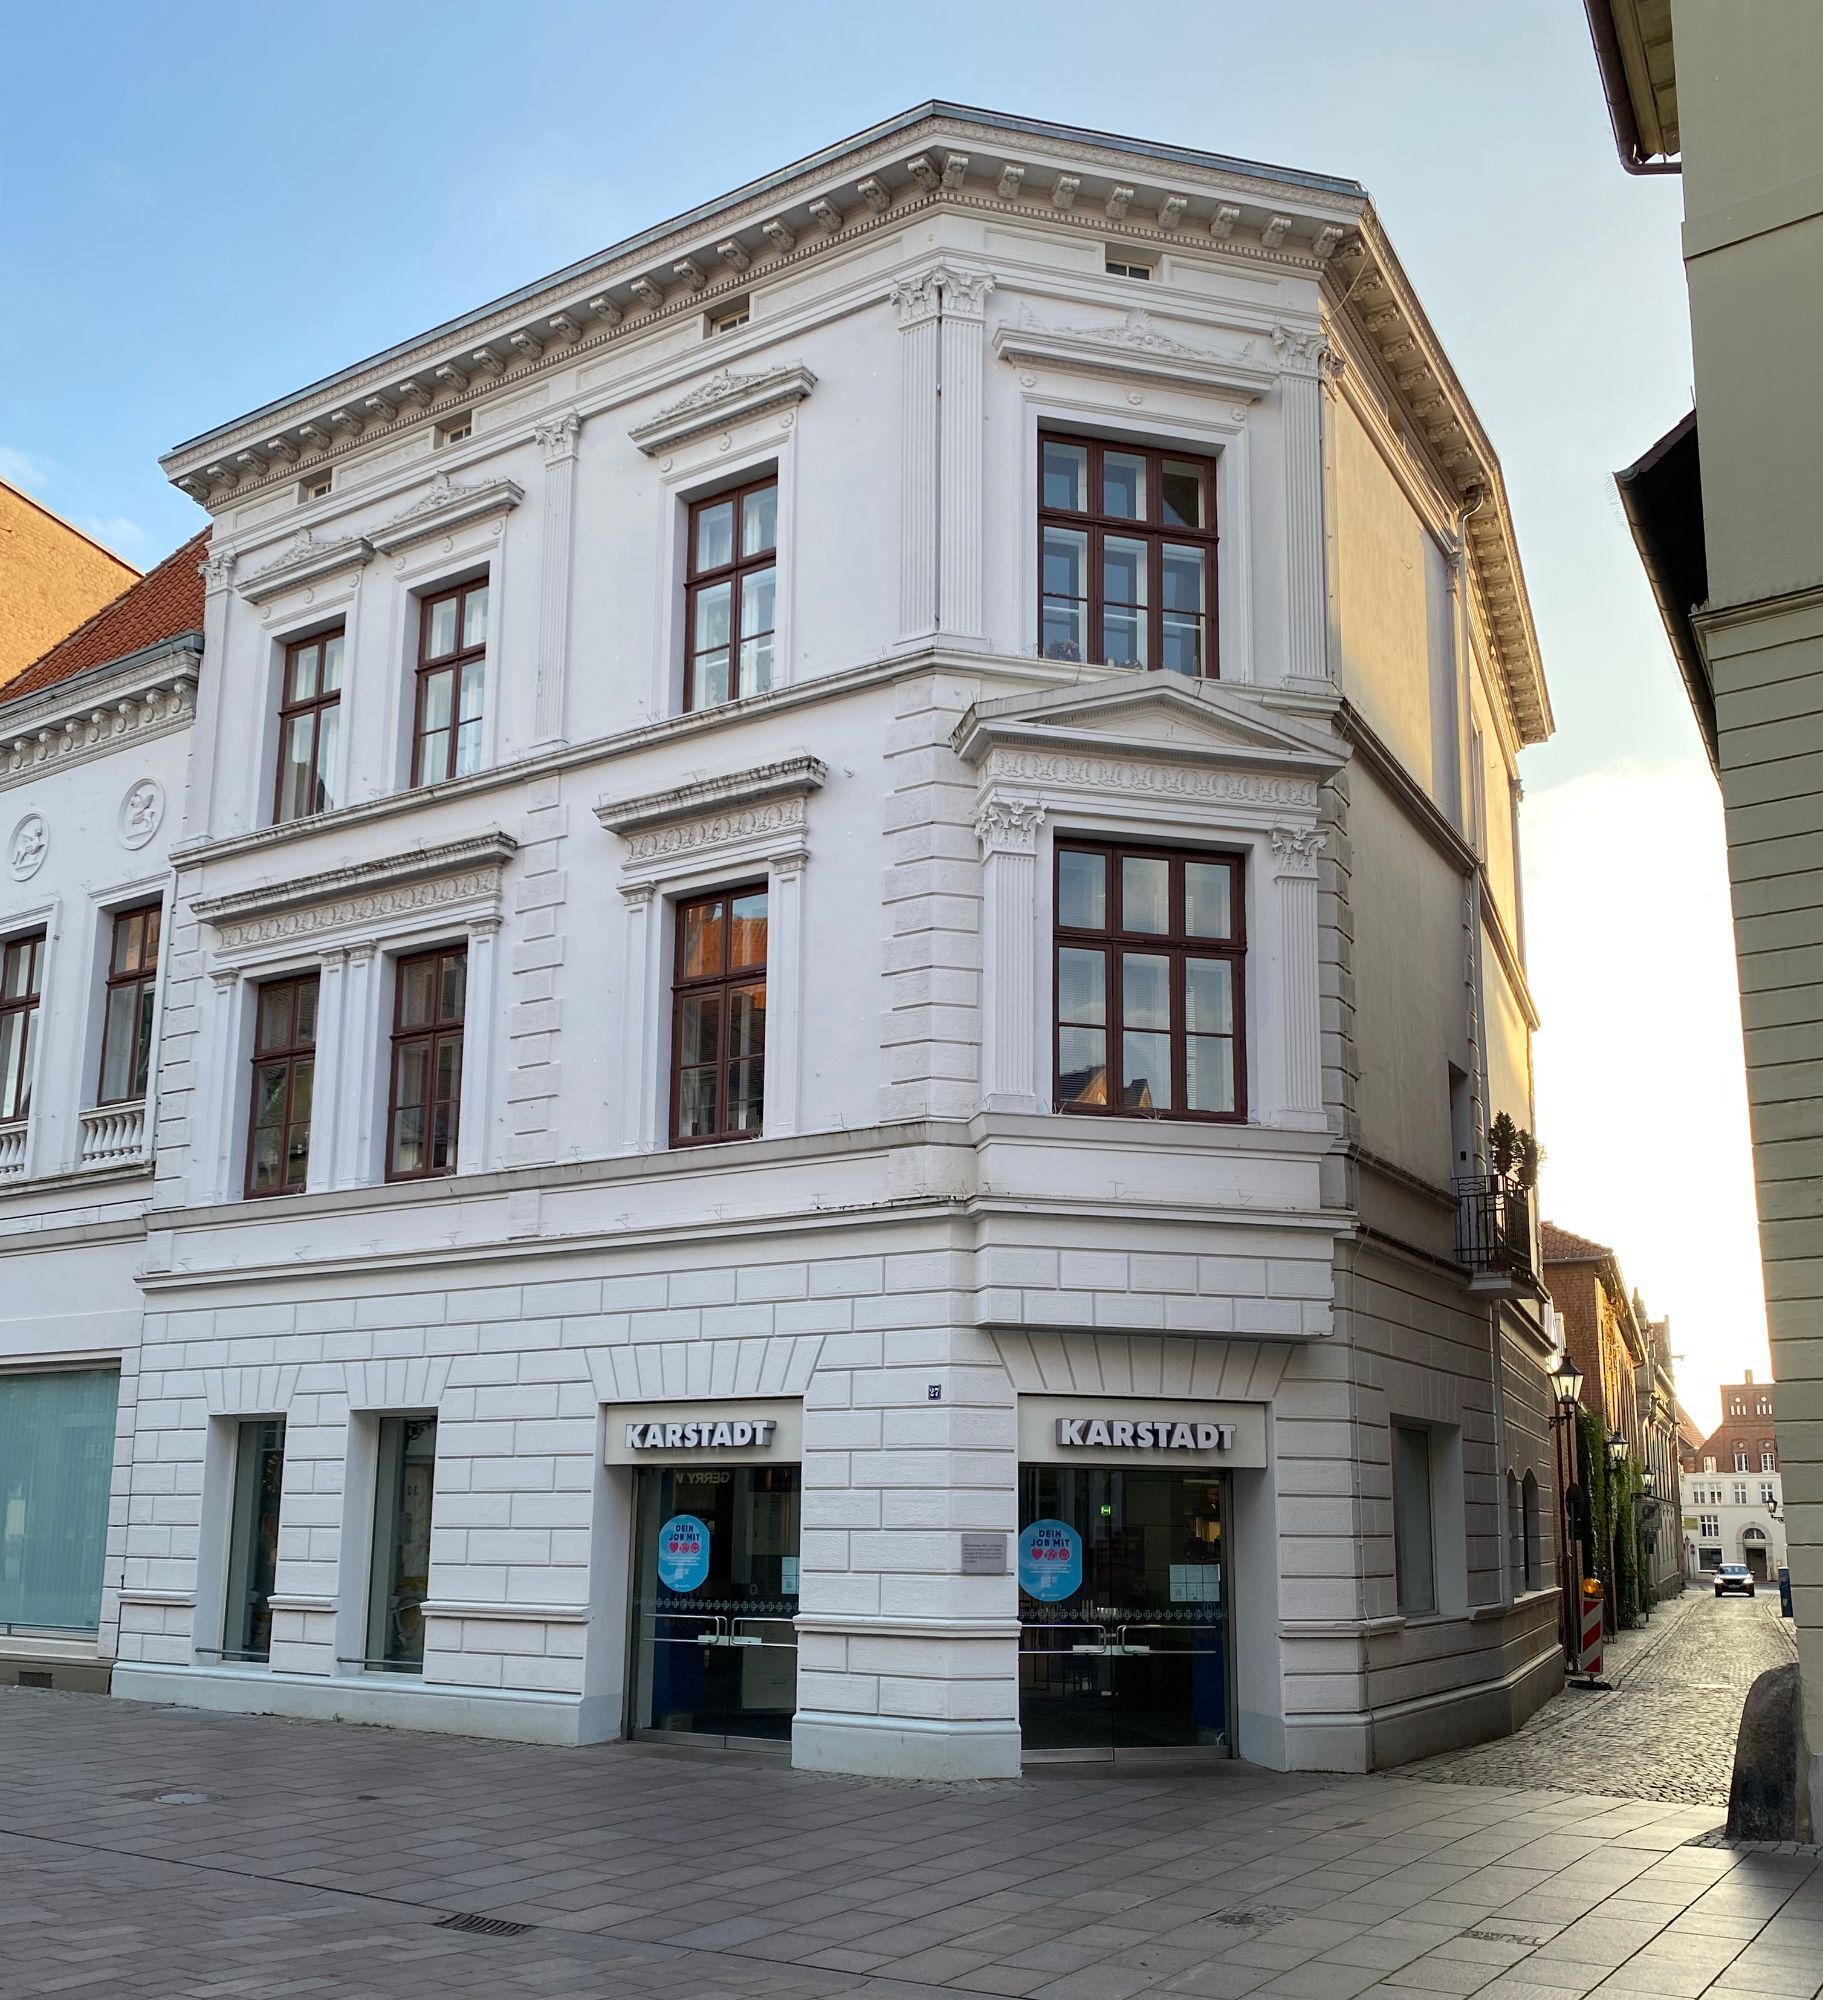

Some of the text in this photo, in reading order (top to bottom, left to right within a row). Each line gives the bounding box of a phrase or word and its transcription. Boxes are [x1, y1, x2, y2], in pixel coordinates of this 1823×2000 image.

[625, 1420, 773, 1448] KARSTADT
[1057, 1418, 1237, 1449] KARSTADT
[675, 1524, 694, 1532] DEIN
[669, 1533, 701, 1541] JOB MIT
[1038, 1529, 1062, 1538] DEIN
[1030, 1539, 1070, 1547] JOB MIT
